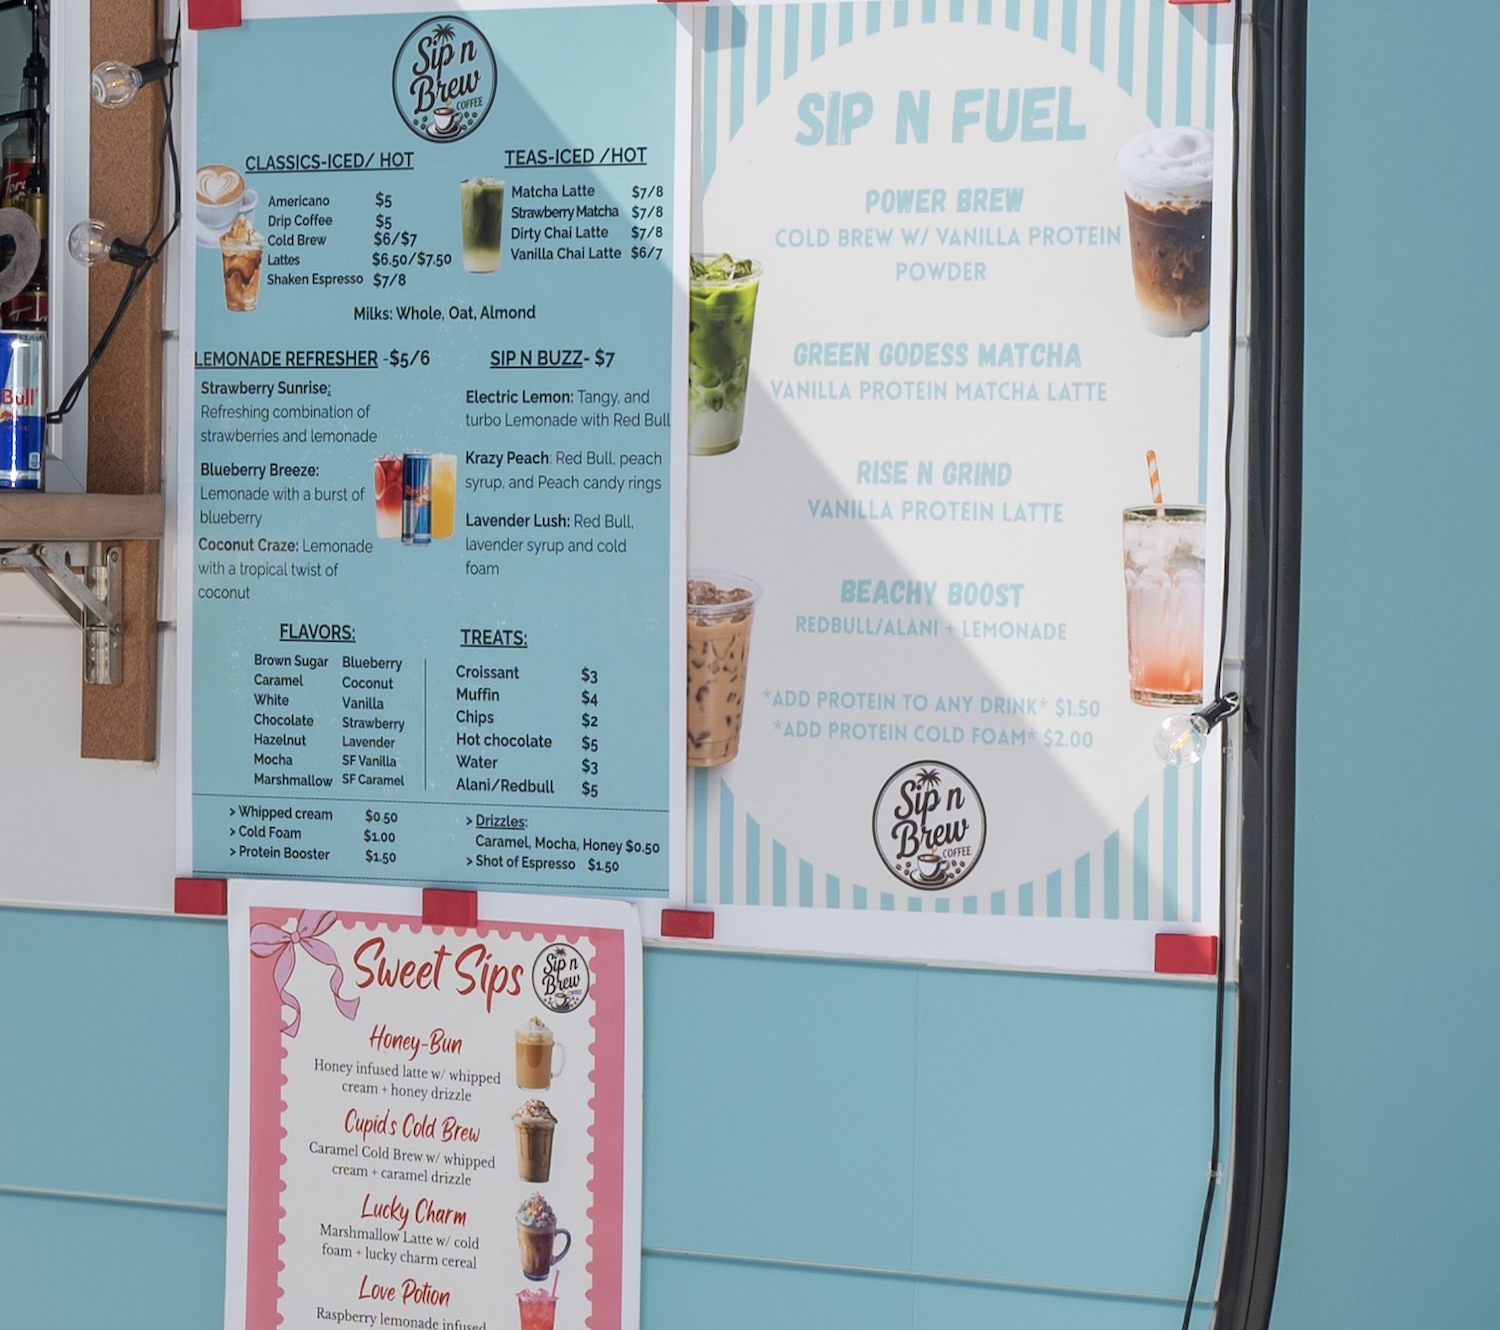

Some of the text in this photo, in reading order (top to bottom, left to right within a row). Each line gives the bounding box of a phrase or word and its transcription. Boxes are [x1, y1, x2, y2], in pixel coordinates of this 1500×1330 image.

[413, 37, 478, 78] Sip n
[409, 71, 481, 114] Brew
[457, 97, 483, 111] COFFEE
[795, 86, 1087, 147] SIP N FUEL
[245, 152, 414, 171] CLASSICS-ICED/ HOT
[505, 147, 647, 167] TEAS-ICED /HOT
[267, 191, 393, 209] Americano $5
[511, 184, 664, 200] Matcha Latte $7/8
[865, 187, 1025, 214] POWER BREW
[268, 213, 392, 230] Drip Coffee $5
[511, 204, 664, 222] Strawberry Matcha $7/8
[267, 230, 418, 248] Cold Brew $6/$7
[511, 225, 663, 243] Dirty Chai Latte $7/8
[267, 251, 452, 268] Lattes $6.50/$7.50
[510, 245, 663, 261] Vanilla Chai Latte $6/7
[267, 272, 407, 289] Shaken Espresso $7/8
[353, 305, 536, 322] Milks: Whole, Oat, Almond
[194, 349, 430, 368] LEMONADE REFRESHER -$5/6
[490, 349, 615, 368] SIP N BUZZ- $7
[793, 342, 1081, 368] GREEN GODESS MATCHA
[2, 388, 34, 405] Bull
[857, 461, 1013, 487] RISE N GRIND
[840, 580, 1024, 608] BEACHY BOOST
[279, 623, 356, 644] FLAVORS:
[460, 628, 528, 649] TREATS:
[893, 780, 965, 820] Sip n
[892, 814, 969, 860] Brew
[942, 845, 971, 859] COFFEE
[353, 936, 524, 1013] Sweet Sips
[543, 953, 579, 975] Sip n
[541, 972, 581, 996] Brew
[369, 1023, 463, 1060] Honey-Bun
[402, 1113, 438, 1140] Cold
[441, 1117, 480, 1143] Brew
[360, 1195, 467, 1230] Lucky Charm
[358, 1274, 450, 1308] Love Potion
